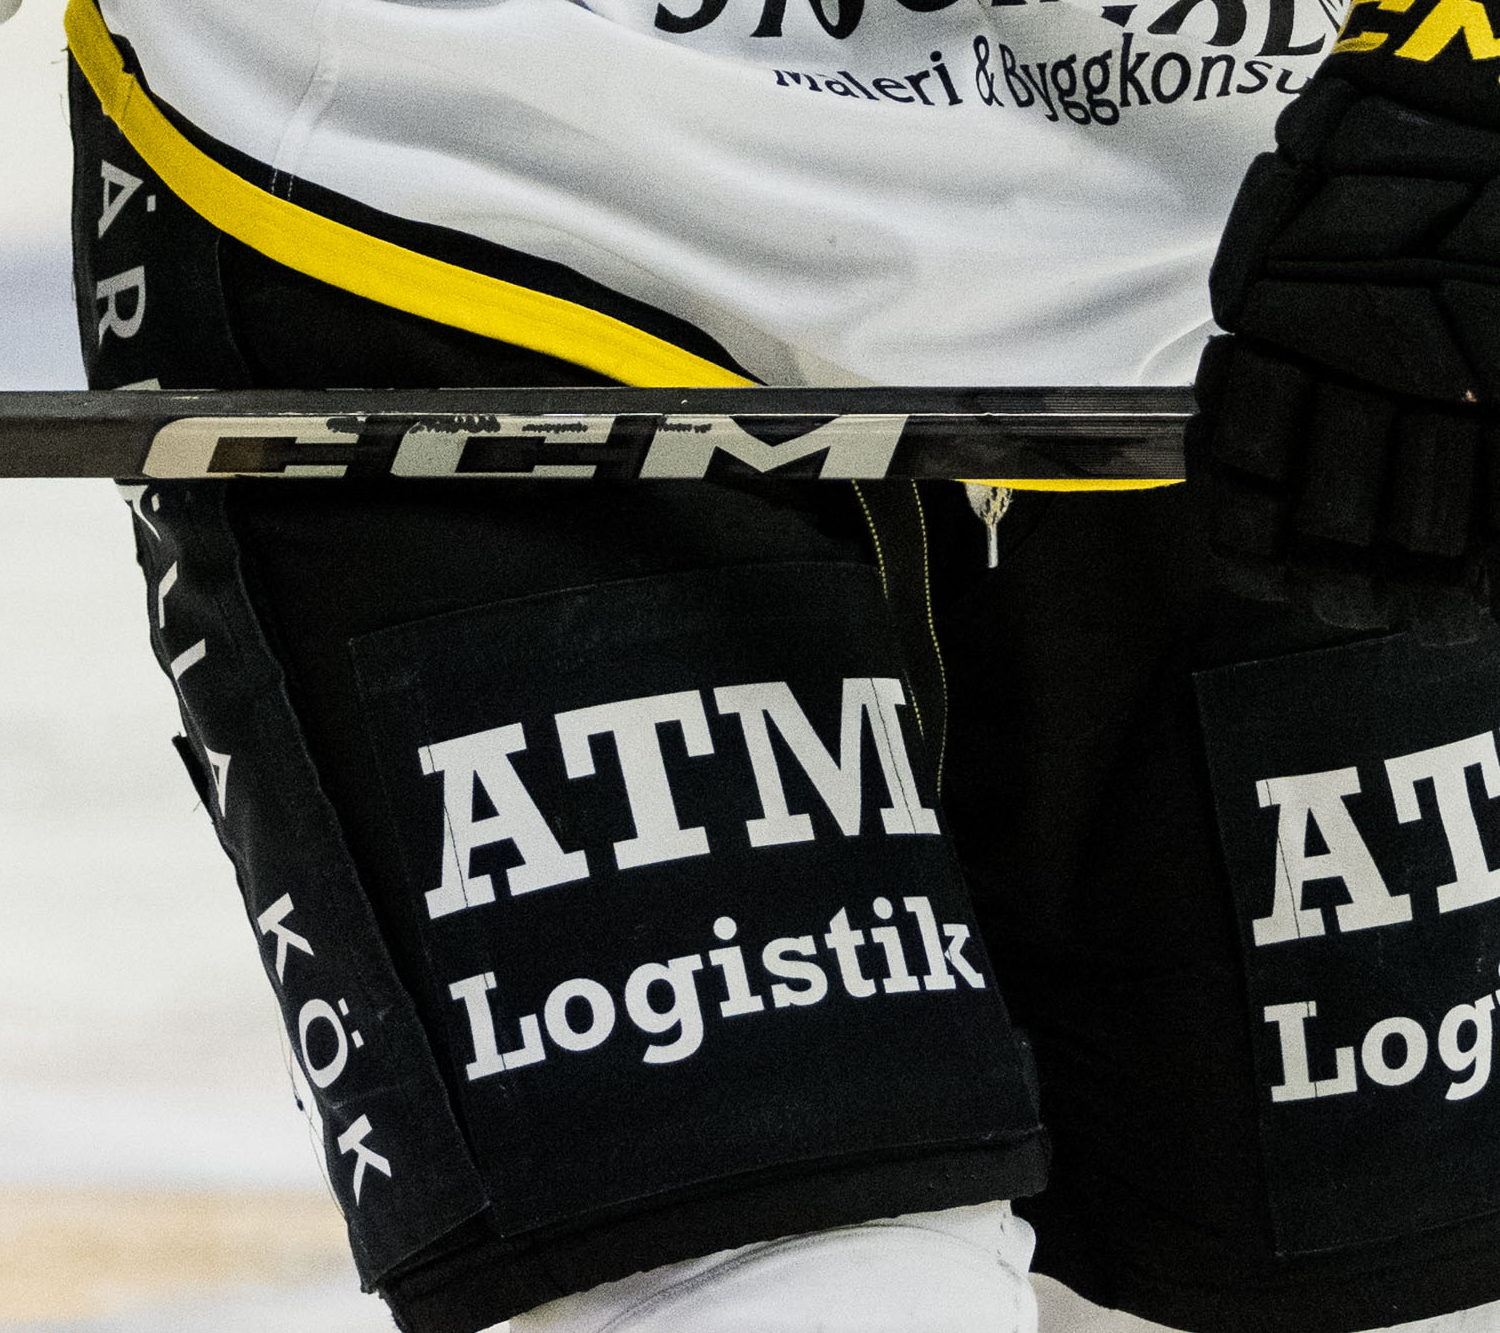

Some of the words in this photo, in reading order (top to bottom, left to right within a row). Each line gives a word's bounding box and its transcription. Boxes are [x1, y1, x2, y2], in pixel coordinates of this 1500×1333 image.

[973, 34, 1005, 108] &
[142, 414, 909, 480] CCM
[418, 677, 941, 920] ATM
[257, 891, 393, 1207] KÖK
[448, 895, 987, 1081] Logistik
